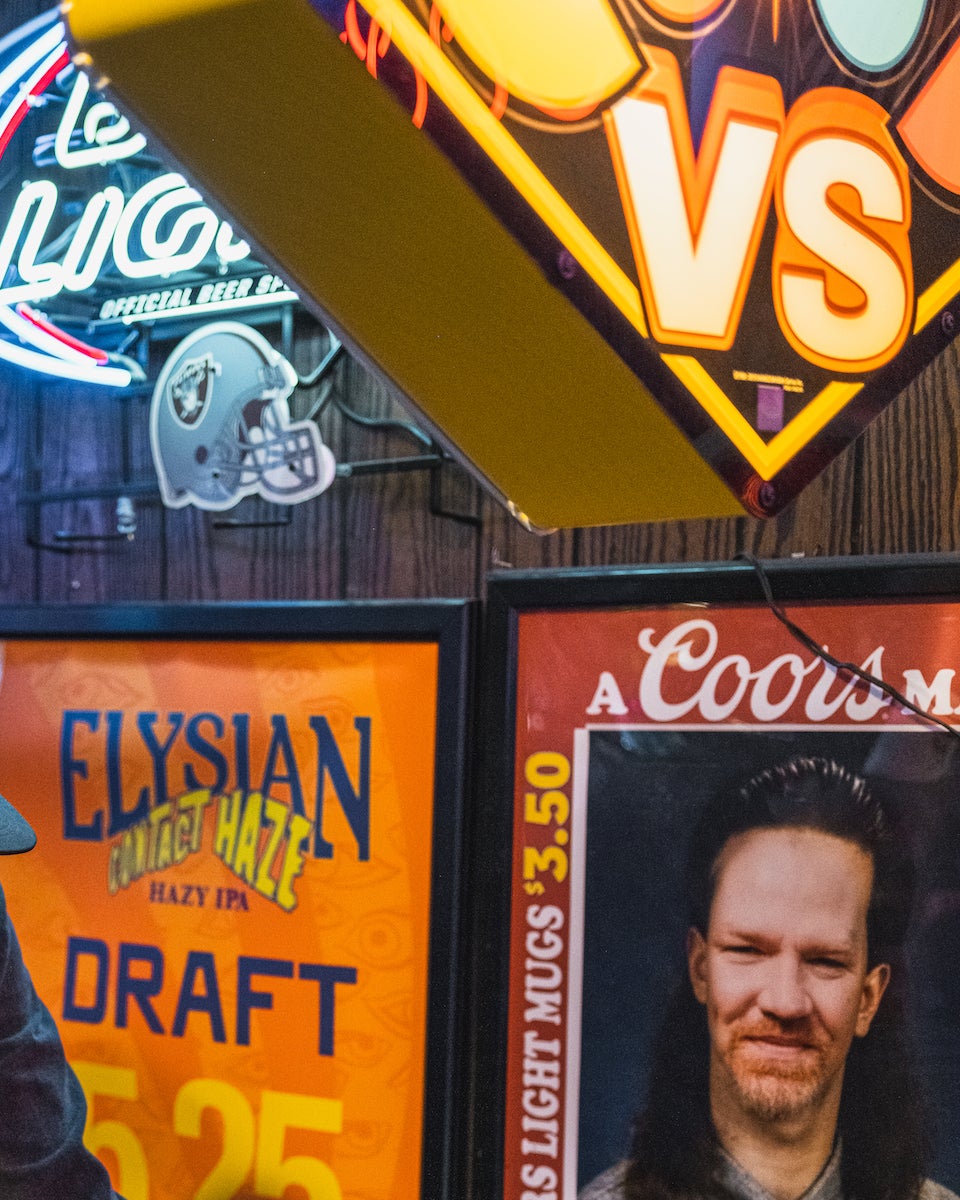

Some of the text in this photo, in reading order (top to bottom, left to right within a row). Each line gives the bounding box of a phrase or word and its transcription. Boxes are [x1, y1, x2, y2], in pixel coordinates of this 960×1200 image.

[604, 68, 912, 370] VS
[99, 287, 192, 320] OFFICIAL
[195, 277, 254, 304] BEER
[586, 619, 960, 721] A Coors M
[59, 709, 371, 862] ELYSIAN
[523, 751, 571, 895] $3.50
[108, 788, 314, 912] CONTACT HAZE
[149, 881, 249, 911] HAZY IPA
[62, 936, 358, 1057] DRAFT
[524, 904, 565, 1025] MUGS
[521, 1031, 561, 1158] LIGHT
